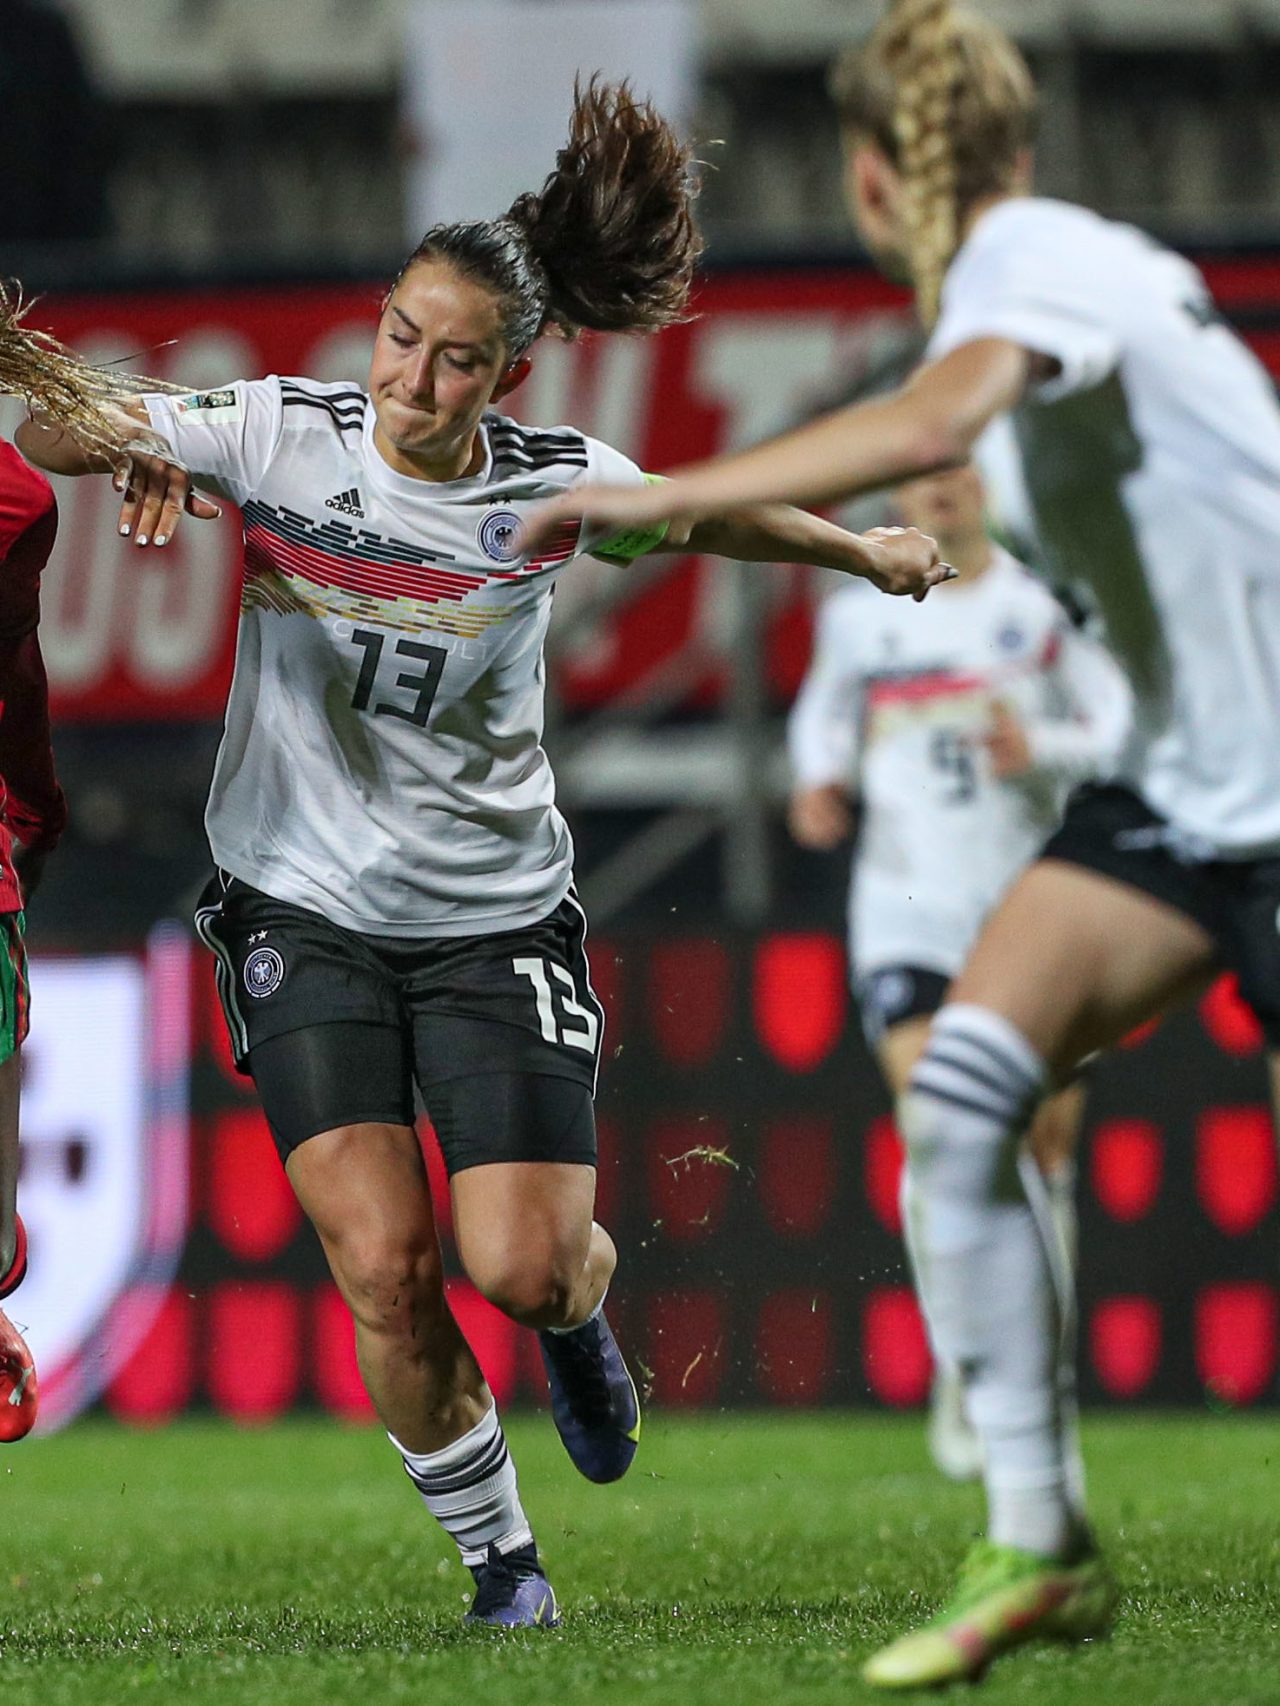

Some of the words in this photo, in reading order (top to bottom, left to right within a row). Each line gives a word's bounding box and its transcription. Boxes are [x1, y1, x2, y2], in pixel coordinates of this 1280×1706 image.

[324, 499, 365, 519] adidas
[350, 628, 448, 728] 13
[928, 725, 976, 806] 9
[512, 957, 597, 1055] 13
